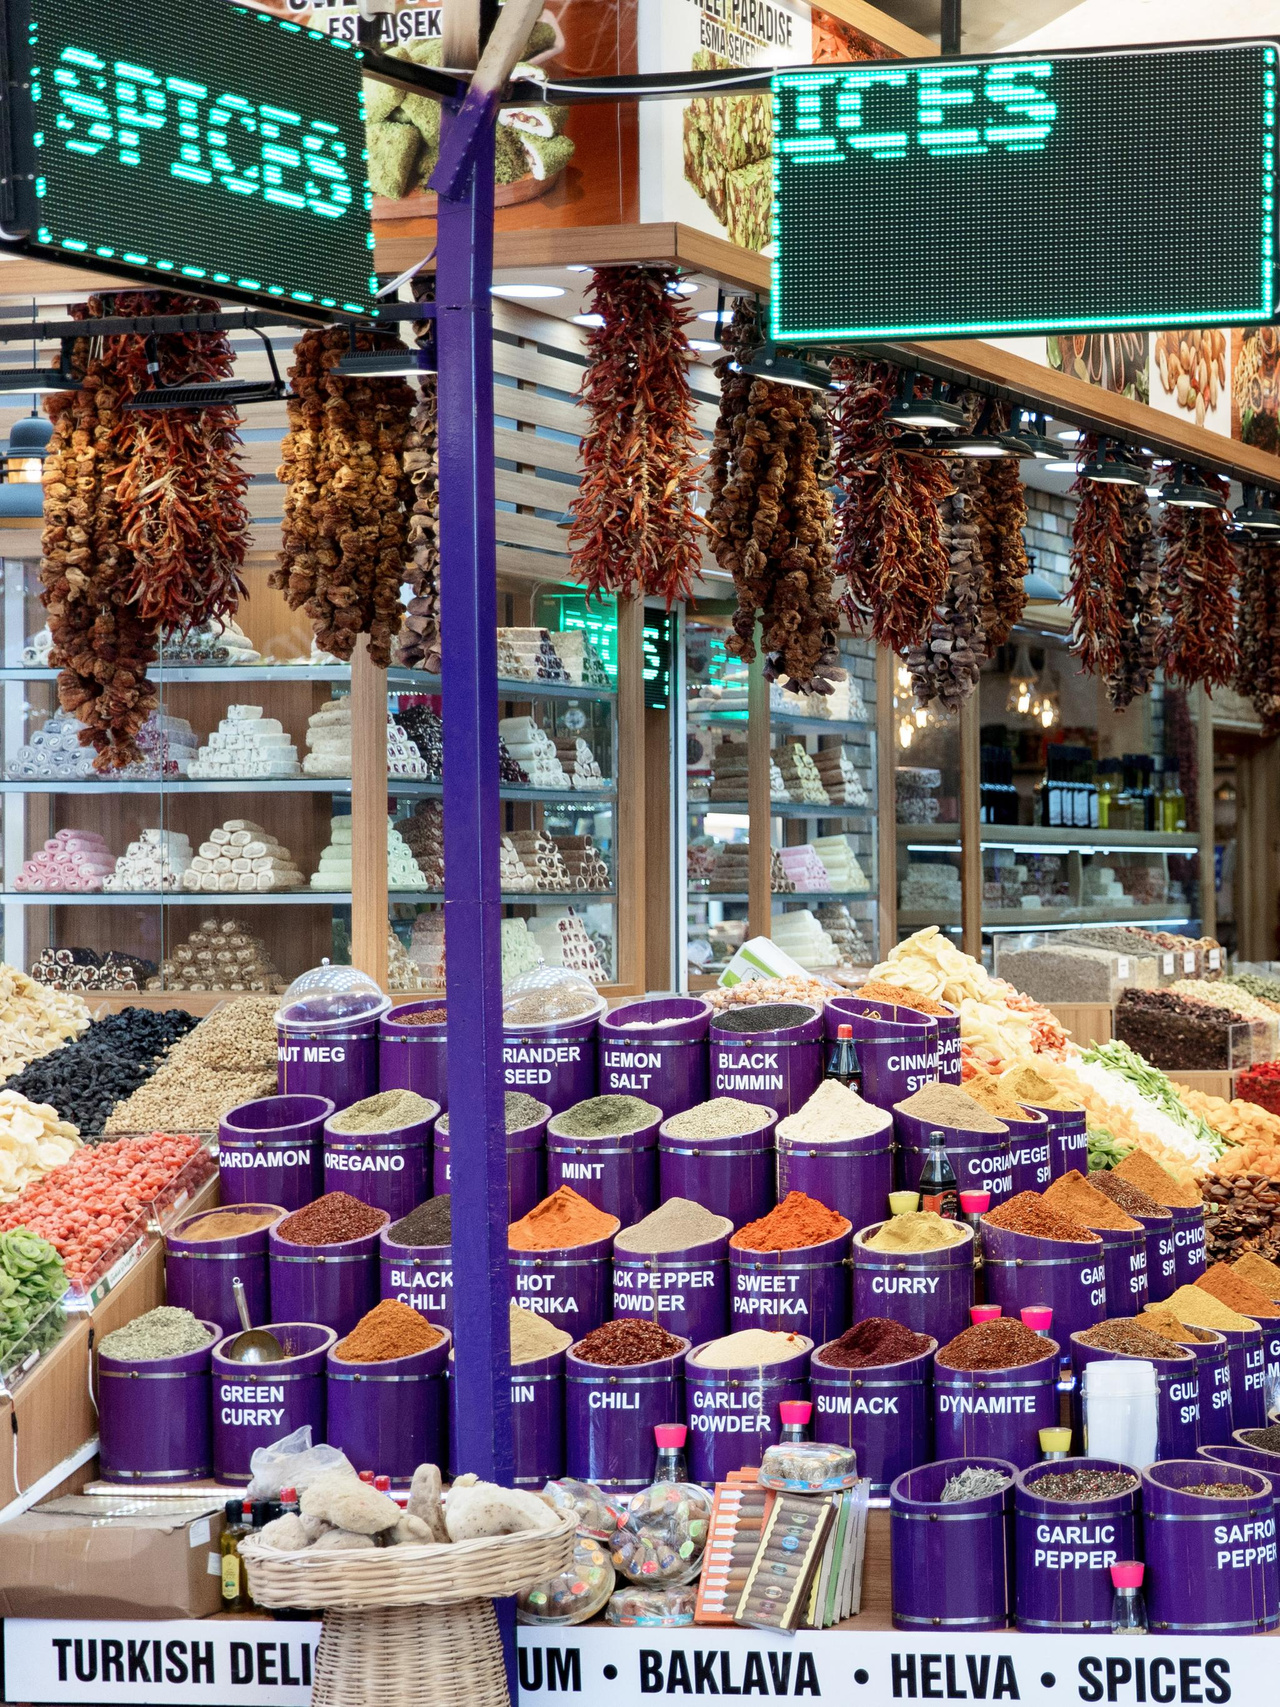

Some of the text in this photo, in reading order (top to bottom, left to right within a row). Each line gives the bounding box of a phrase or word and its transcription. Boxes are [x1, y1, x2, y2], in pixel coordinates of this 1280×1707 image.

[399, 9, 442, 42] ŞEK
[732, 0, 793, 48] PARADISE
[700, 18, 726, 56] ESMA
[54, 46, 352, 218] SPICES
[278, 1046, 346, 1063] NUT MEG
[502, 1046, 581, 1064] RIANDER
[604, 1051, 662, 1069] LEMON
[718, 1053, 779, 1069] BLACK
[504, 1069, 552, 1084] SEED
[610, 1073, 652, 1090] SALT
[716, 1074, 784, 1090] CUMMIN
[219, 1149, 311, 1169] CARDAMON
[324, 1153, 405, 1172] OREGANO
[561, 1163, 605, 1180] MINT
[390, 1270, 453, 1288] BLACK
[516, 1274, 555, 1291] HOT
[637, 1270, 715, 1290] PEPPER
[737, 1275, 800, 1292] SWEET
[1080, 1264, 1105, 1285] GAR
[871, 1277, 940, 1294] CURRY
[396, 1293, 446, 1310] CHILI
[509, 1296, 579, 1314] APRIKA
[613, 1292, 686, 1312] POWDER
[733, 1297, 809, 1315] PAPRIKA
[220, 1384, 284, 1403] GREEN
[588, 1391, 640, 1409] CHILI
[693, 1391, 763, 1409] GARLIC
[816, 1395, 899, 1414] SUMACK
[939, 1395, 1036, 1413] DYNAMITE
[221, 1407, 285, 1426] CURRY
[690, 1414, 771, 1433] POWDER
[1036, 1524, 1115, 1544] GARLIC
[1214, 1518, 1276, 1544] SAFRON
[1035, 1549, 1117, 1569] PEPPER
[1217, 1543, 1277, 1569] PEPPER
[52, 1638, 215, 1684] TURKISH
[230, 1641, 318, 1687] DELI
[639, 1648, 822, 1697] BAKLAVA
[891, 1653, 1021, 1700] HELVA
[1077, 1655, 1232, 1704] SPICES
